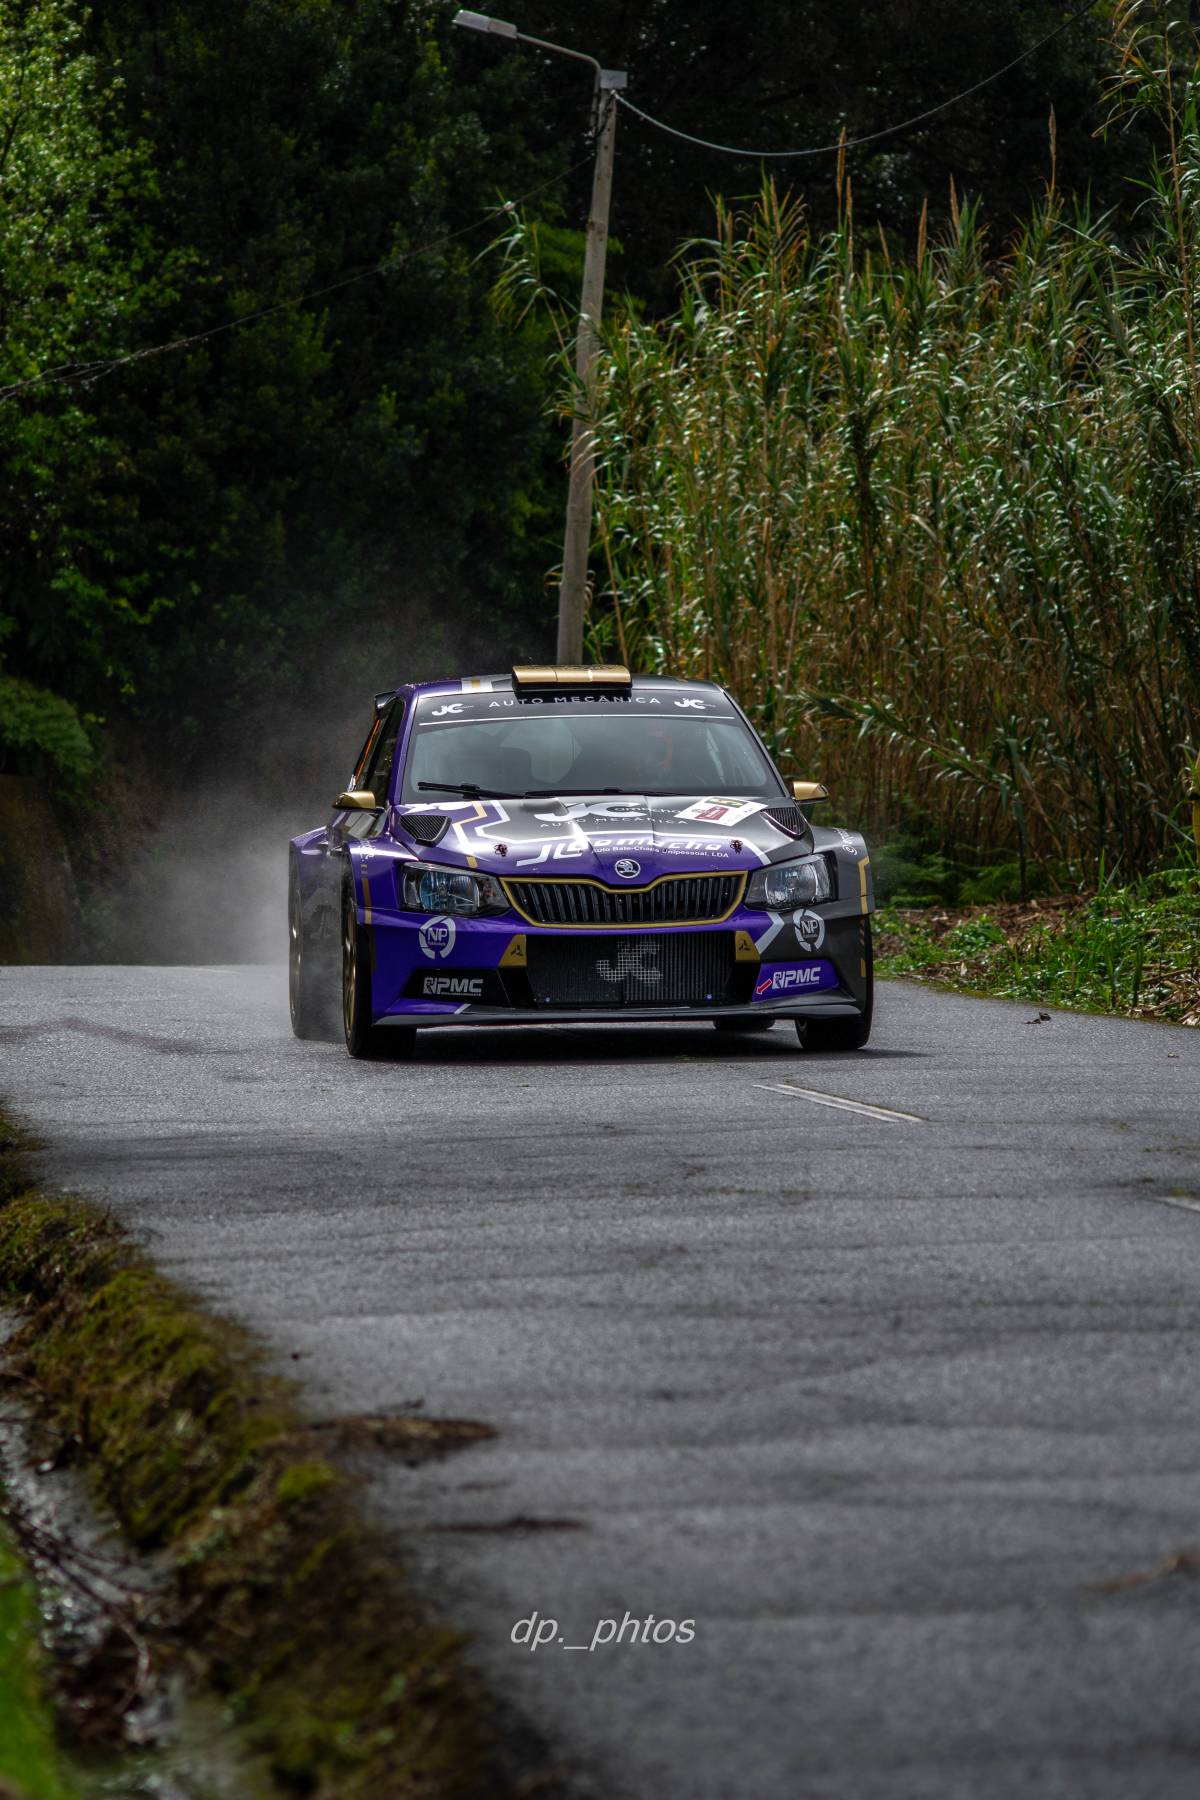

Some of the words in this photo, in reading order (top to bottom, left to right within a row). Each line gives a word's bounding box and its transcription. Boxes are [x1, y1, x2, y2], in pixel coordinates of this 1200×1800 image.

[488, 698, 544, 708] AUTO
[554, 694, 661, 704] MECÂNICA
[540, 817, 587, 828] AUTO
[800, 919, 818, 934] NP
[427, 927, 448, 942] NP
